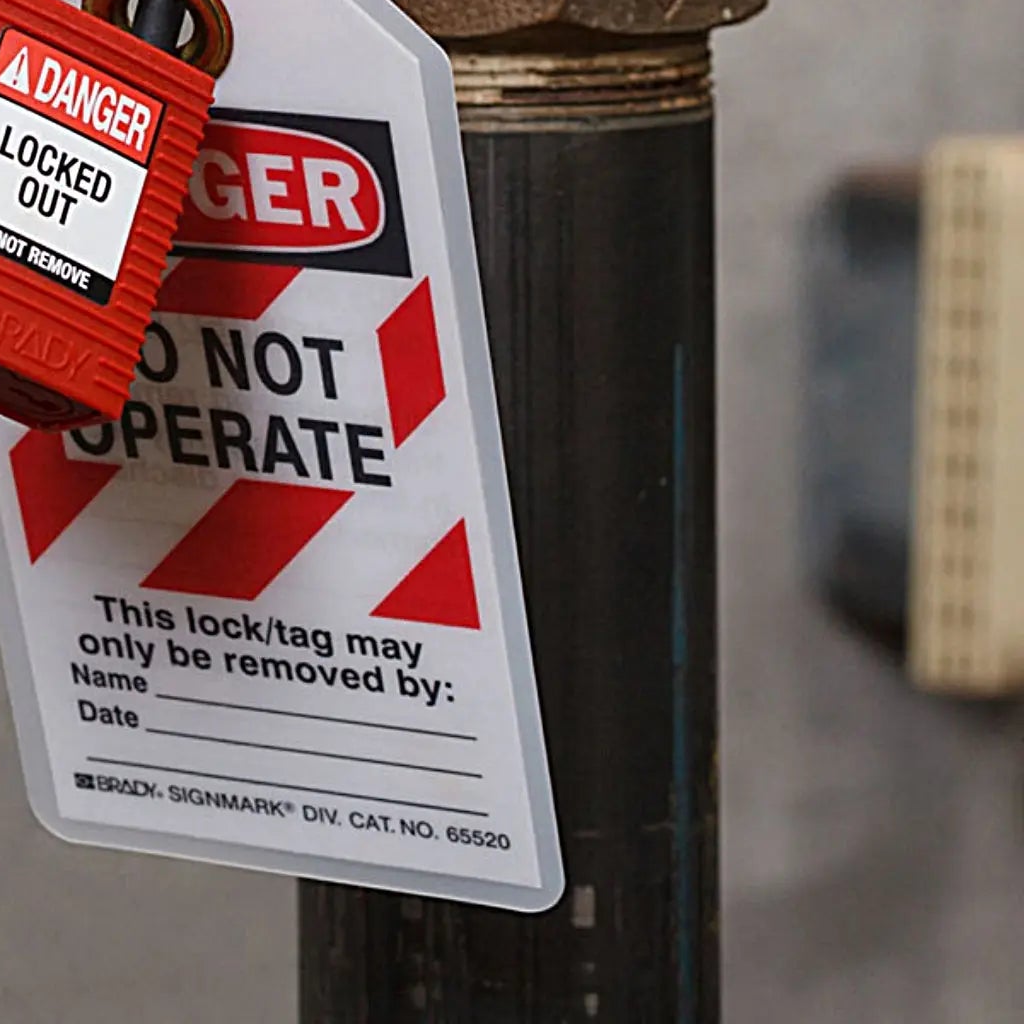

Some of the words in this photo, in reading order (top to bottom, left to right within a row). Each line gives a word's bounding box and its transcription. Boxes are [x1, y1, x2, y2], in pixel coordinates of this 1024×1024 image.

[34, 57, 151, 152] DANGER
[17, 176, 78, 226] OUT
[188, 148, 367, 232] GER
[27, 246, 92, 290] REMOVE
[136, 319, 179, 383] O
[201, 326, 344, 400] NOT
[93, 594, 176, 631] This
[187, 606, 334, 657] lock/tag
[347, 631, 423, 669] may
[71, 662, 148, 694] Name
[78, 630, 155, 668] only
[169, 640, 212, 670] be
[224, 649, 384, 693] removed
[398, 668, 456, 707] by:
[77, 699, 140, 728] Date
[302, 805, 342, 826] DIV.
[349, 811, 395, 834] CAT.
[400, 819, 439, 840] NO.
[446, 826, 511, 850] 65520
